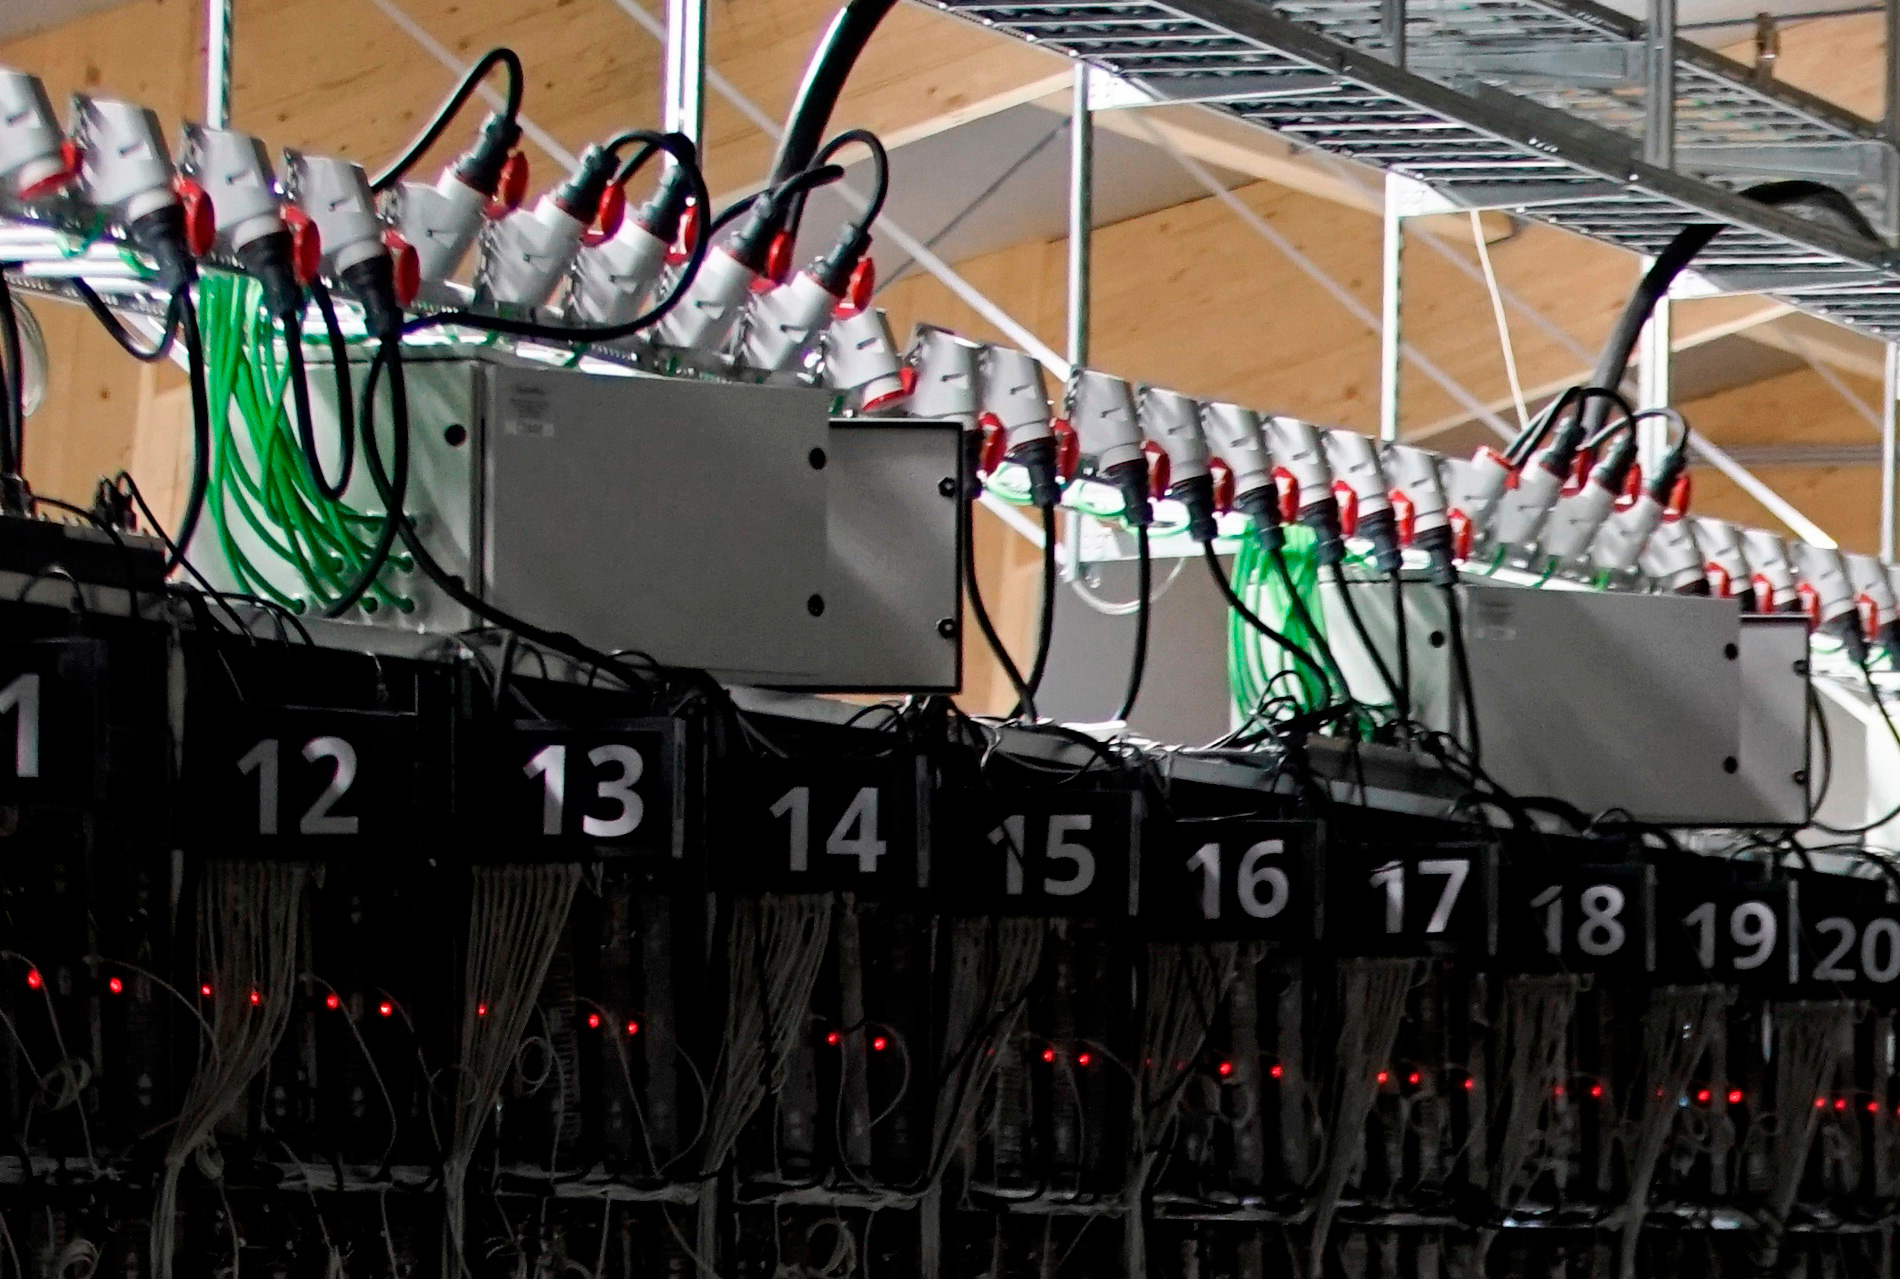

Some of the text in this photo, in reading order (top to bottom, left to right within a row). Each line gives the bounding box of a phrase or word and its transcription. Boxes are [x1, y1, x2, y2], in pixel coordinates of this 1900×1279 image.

[237, 737, 359, 835] 12
[522, 744, 644, 838] 13
[769, 786, 886, 872] 14
[988, 814, 1095, 896] 15
[1187, 839, 1290, 920] 16
[1369, 859, 1469, 933] 17
[1531, 885, 1625, 955] 18
[1683, 901, 1777, 969] 19
